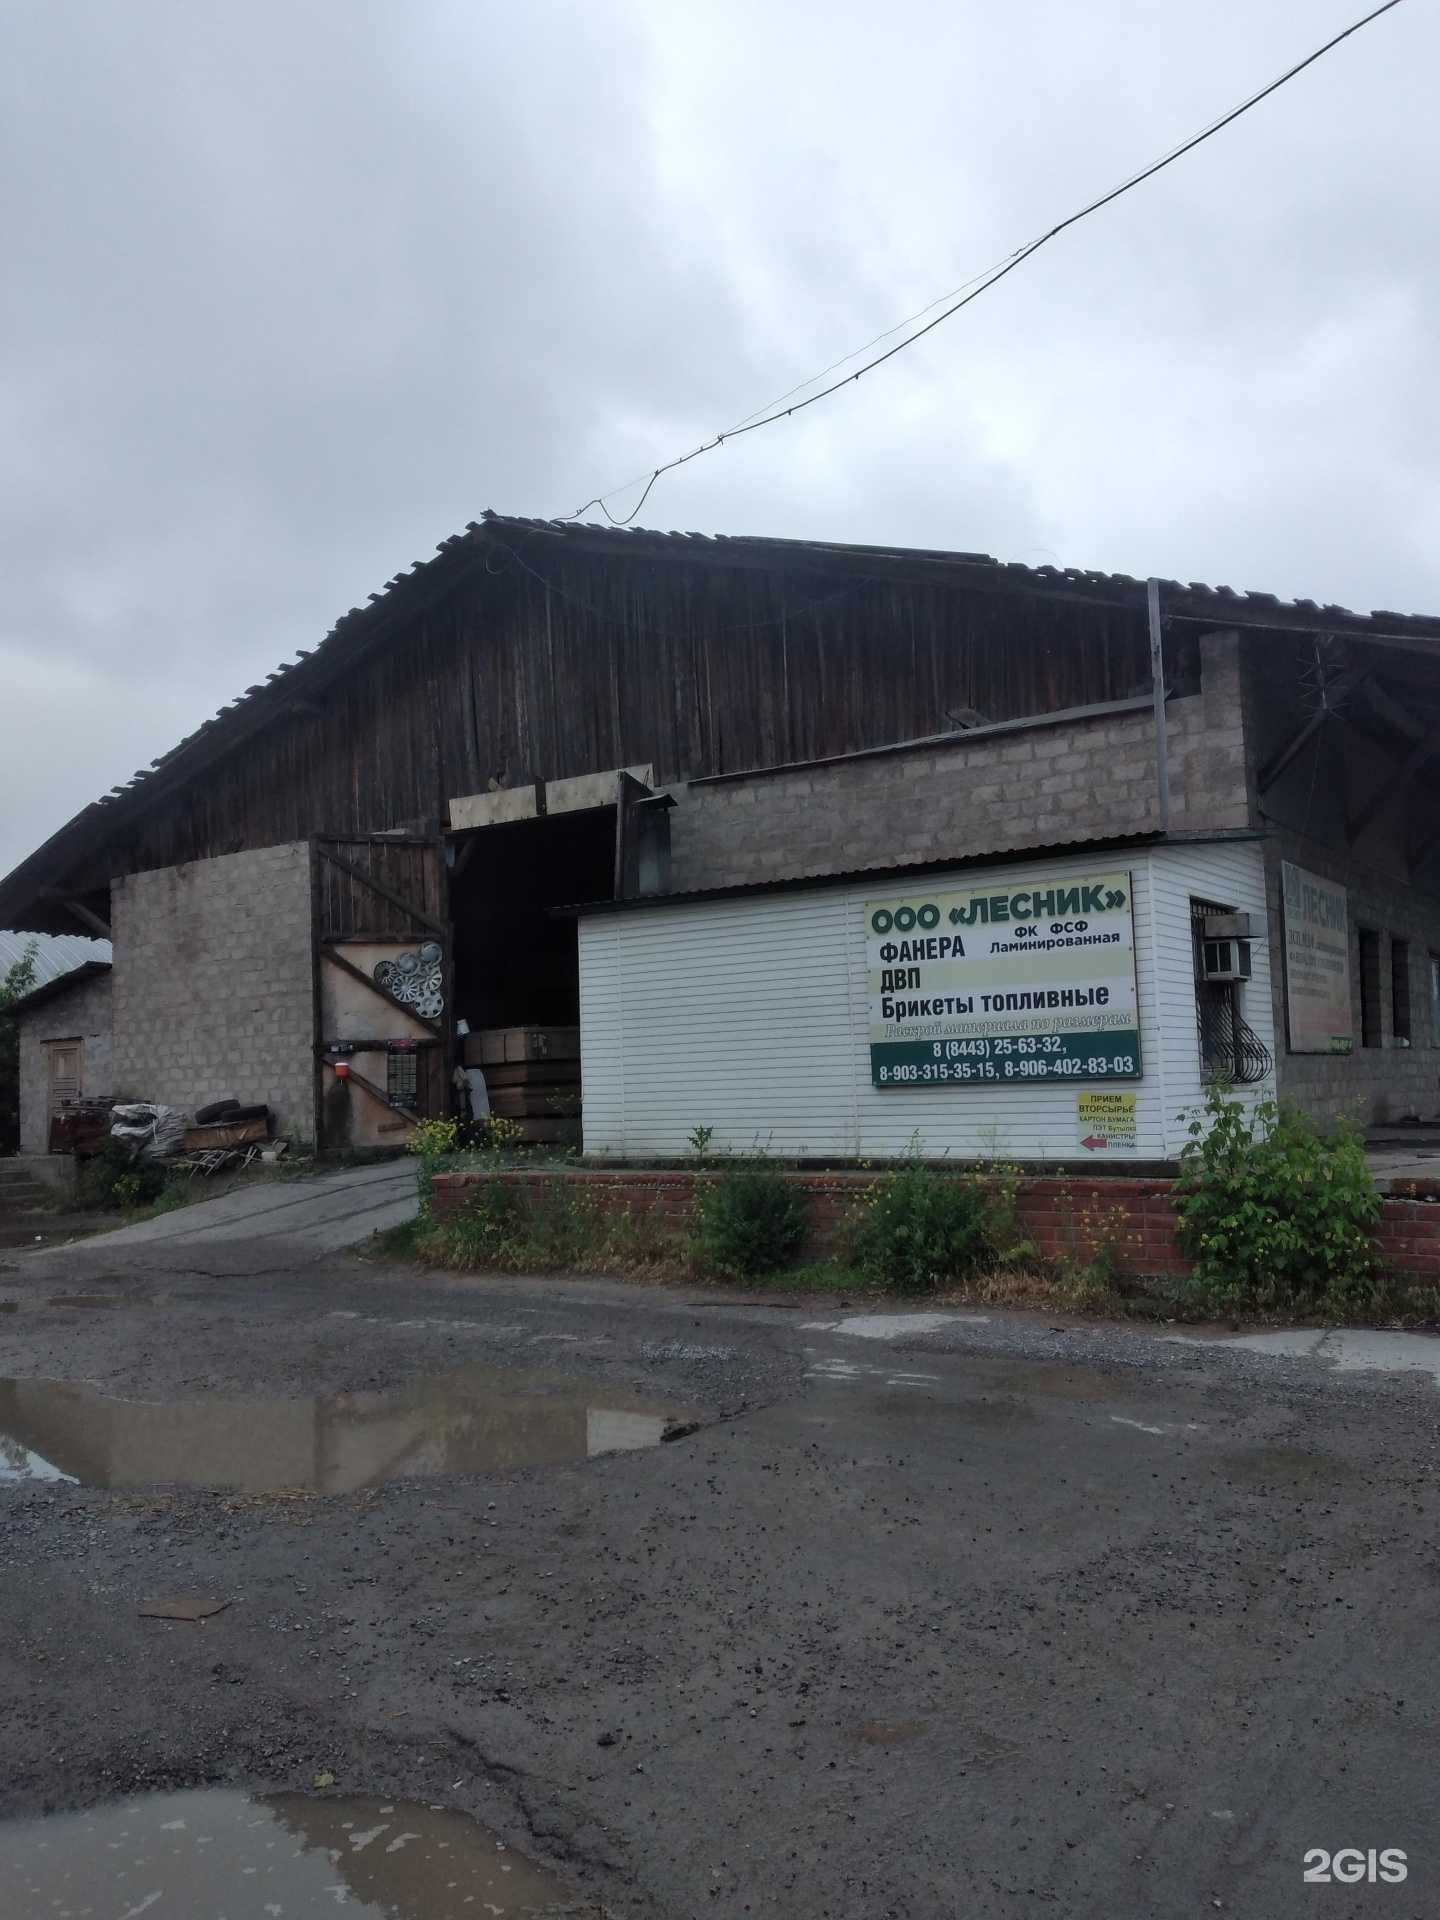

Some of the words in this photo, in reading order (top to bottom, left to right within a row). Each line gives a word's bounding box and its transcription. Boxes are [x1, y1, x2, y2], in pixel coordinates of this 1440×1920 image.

[871, 903, 940, 934] ООО
[948, 884, 1127, 925] «ЛЕСНИК»
[1014, 925, 1038, 939] ФК
[1049, 920, 1089, 936] ФСФ
[879, 935, 965, 963] ФАНЕРА
[989, 931, 1121, 954] Ламинированная
[880, 967, 921, 993] ДВП
[882, 996, 974, 1022] Брикеты
[980, 986, 1109, 1012] топливные
[933, 1043, 942, 1057] 8
[945, 1039, 990, 1060] (8443)
[994, 1036, 1067, 1055] 25-63-32,
[879, 1061, 1000, 1081] 8-903-315-35-15,
[1004, 1056, 1134, 1078] 8-906-402-83-03
[1090, 1095, 1122, 1103] ПРИЕМ
